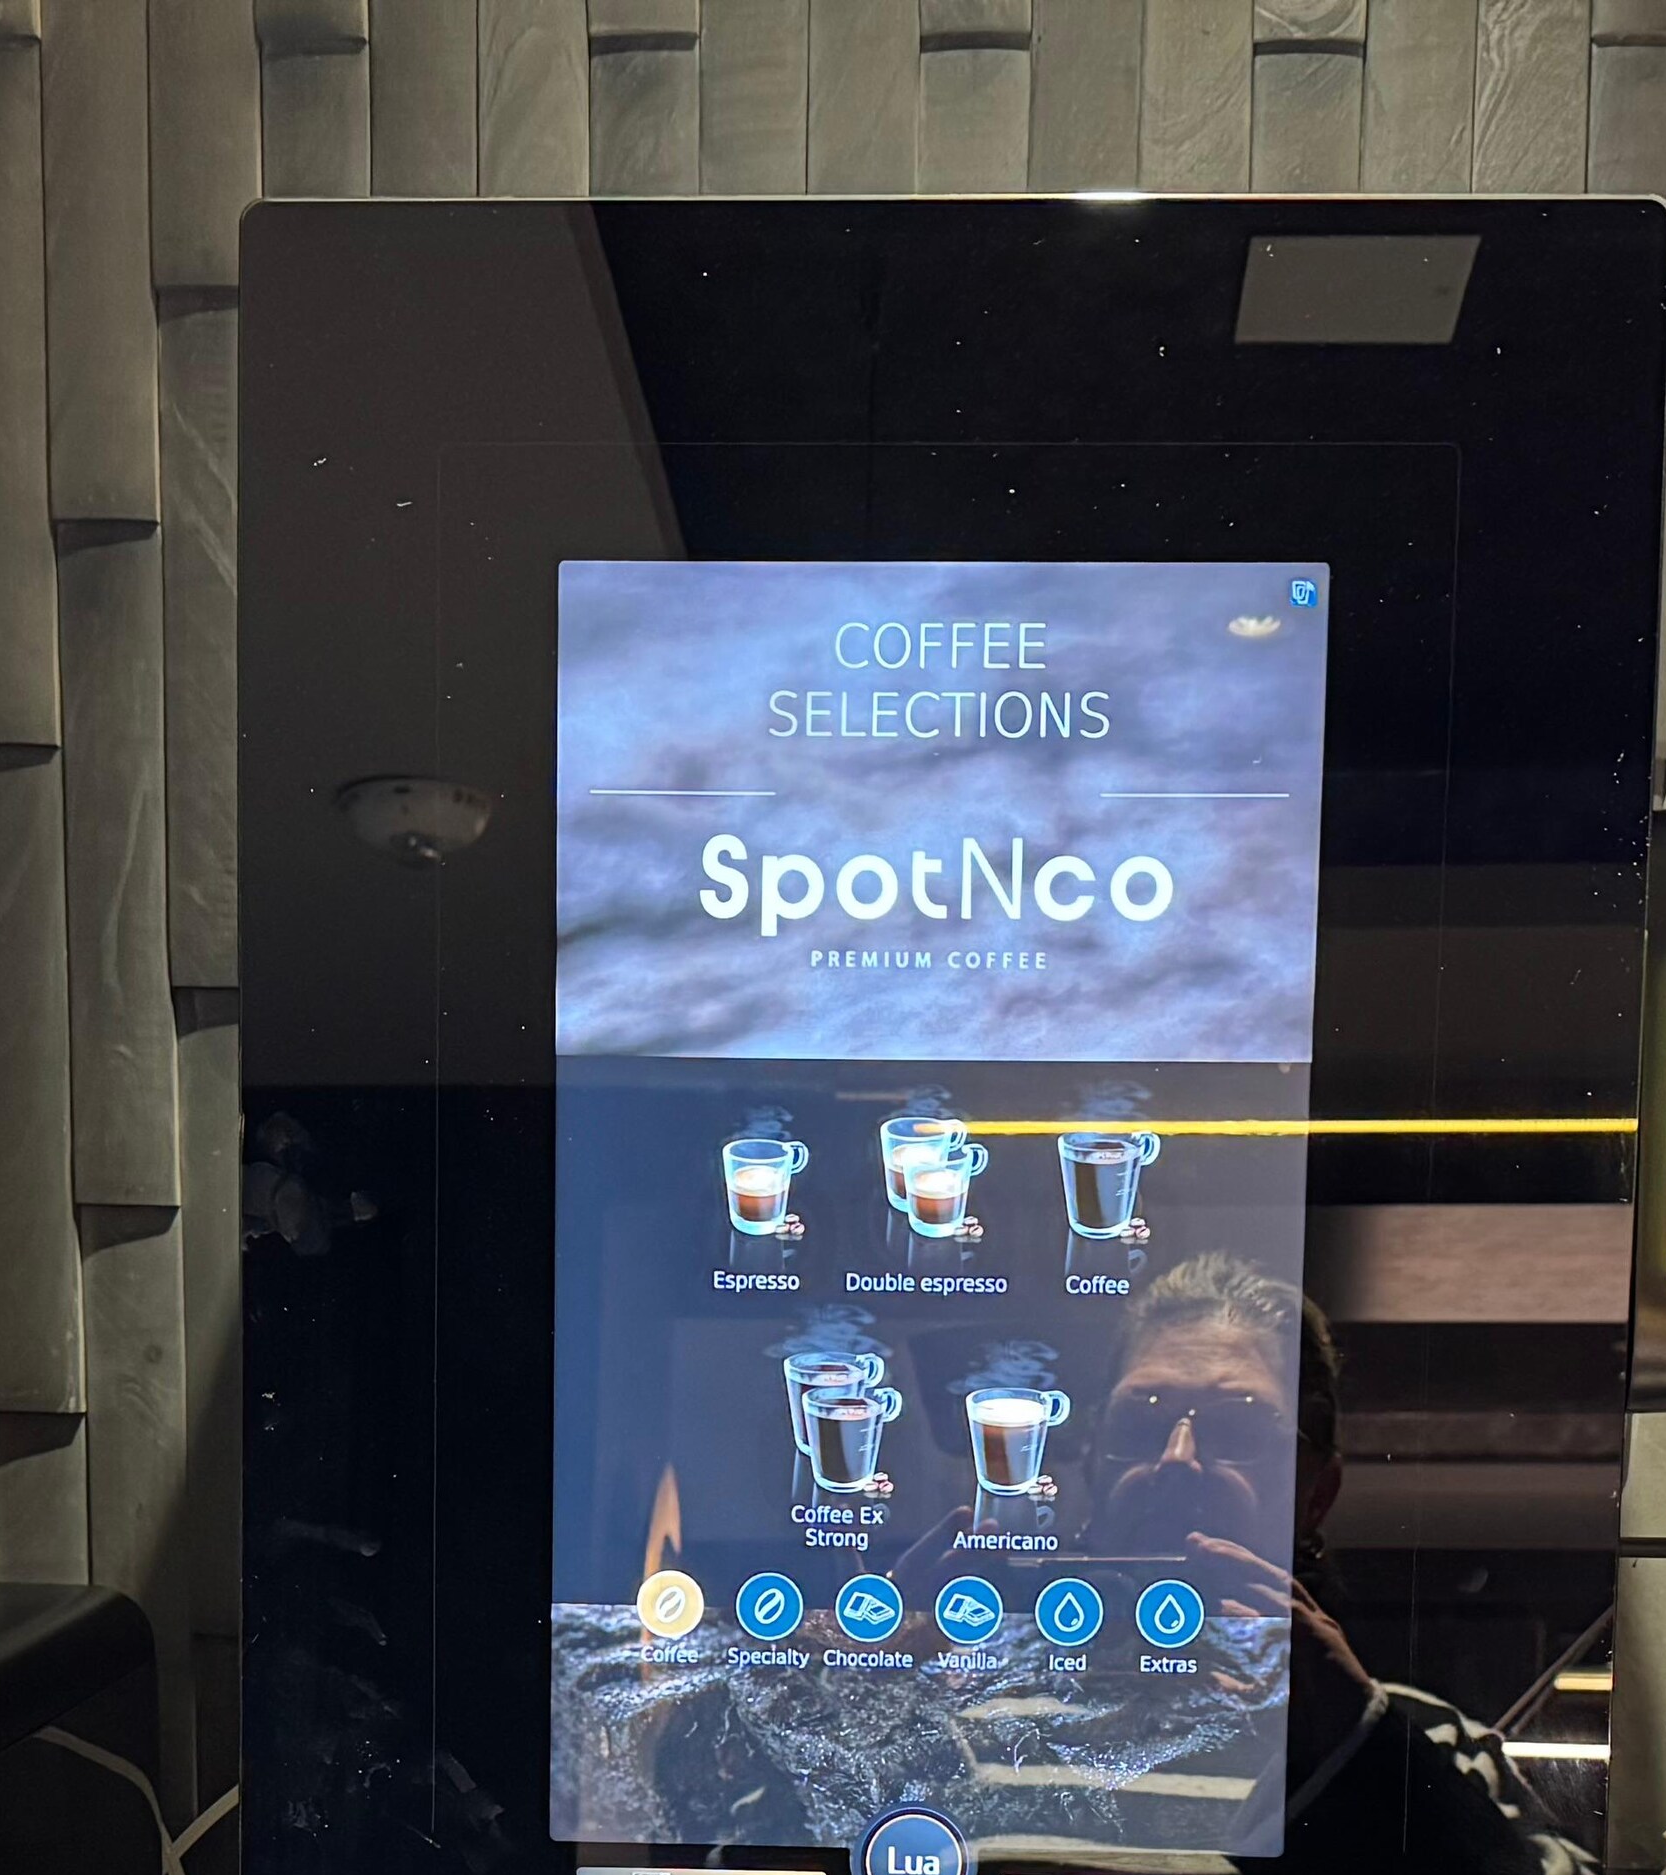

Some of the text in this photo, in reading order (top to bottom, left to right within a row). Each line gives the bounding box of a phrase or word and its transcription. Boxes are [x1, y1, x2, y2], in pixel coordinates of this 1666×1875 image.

[834, 622, 1047, 669] COFFEE
[768, 691, 1111, 738] SELECTIONS
[699, 834, 1173, 937] SpotNco
[810, 950, 1047, 969] PREMIUM COFFEE
[713, 1271, 799, 1293] Espresso
[846, 1272, 1007, 1297] Double espresso
[1065, 1274, 1129, 1295] Coffee
[791, 1505, 883, 1527] Coffee Ex
[805, 1529, 869, 1552] Strong
[953, 1531, 1058, 1551] Americano
[641, 1644, 698, 1664] Coffee
[728, 1647, 809, 1669] Specialty
[823, 1648, 913, 1668] Chocolate
[937, 1651, 996, 1671] Vanilla
[1048, 1653, 1085, 1672] Iced
[1139, 1655, 1197, 1675] Extras
[888, 1845, 940, 1875] Lua
